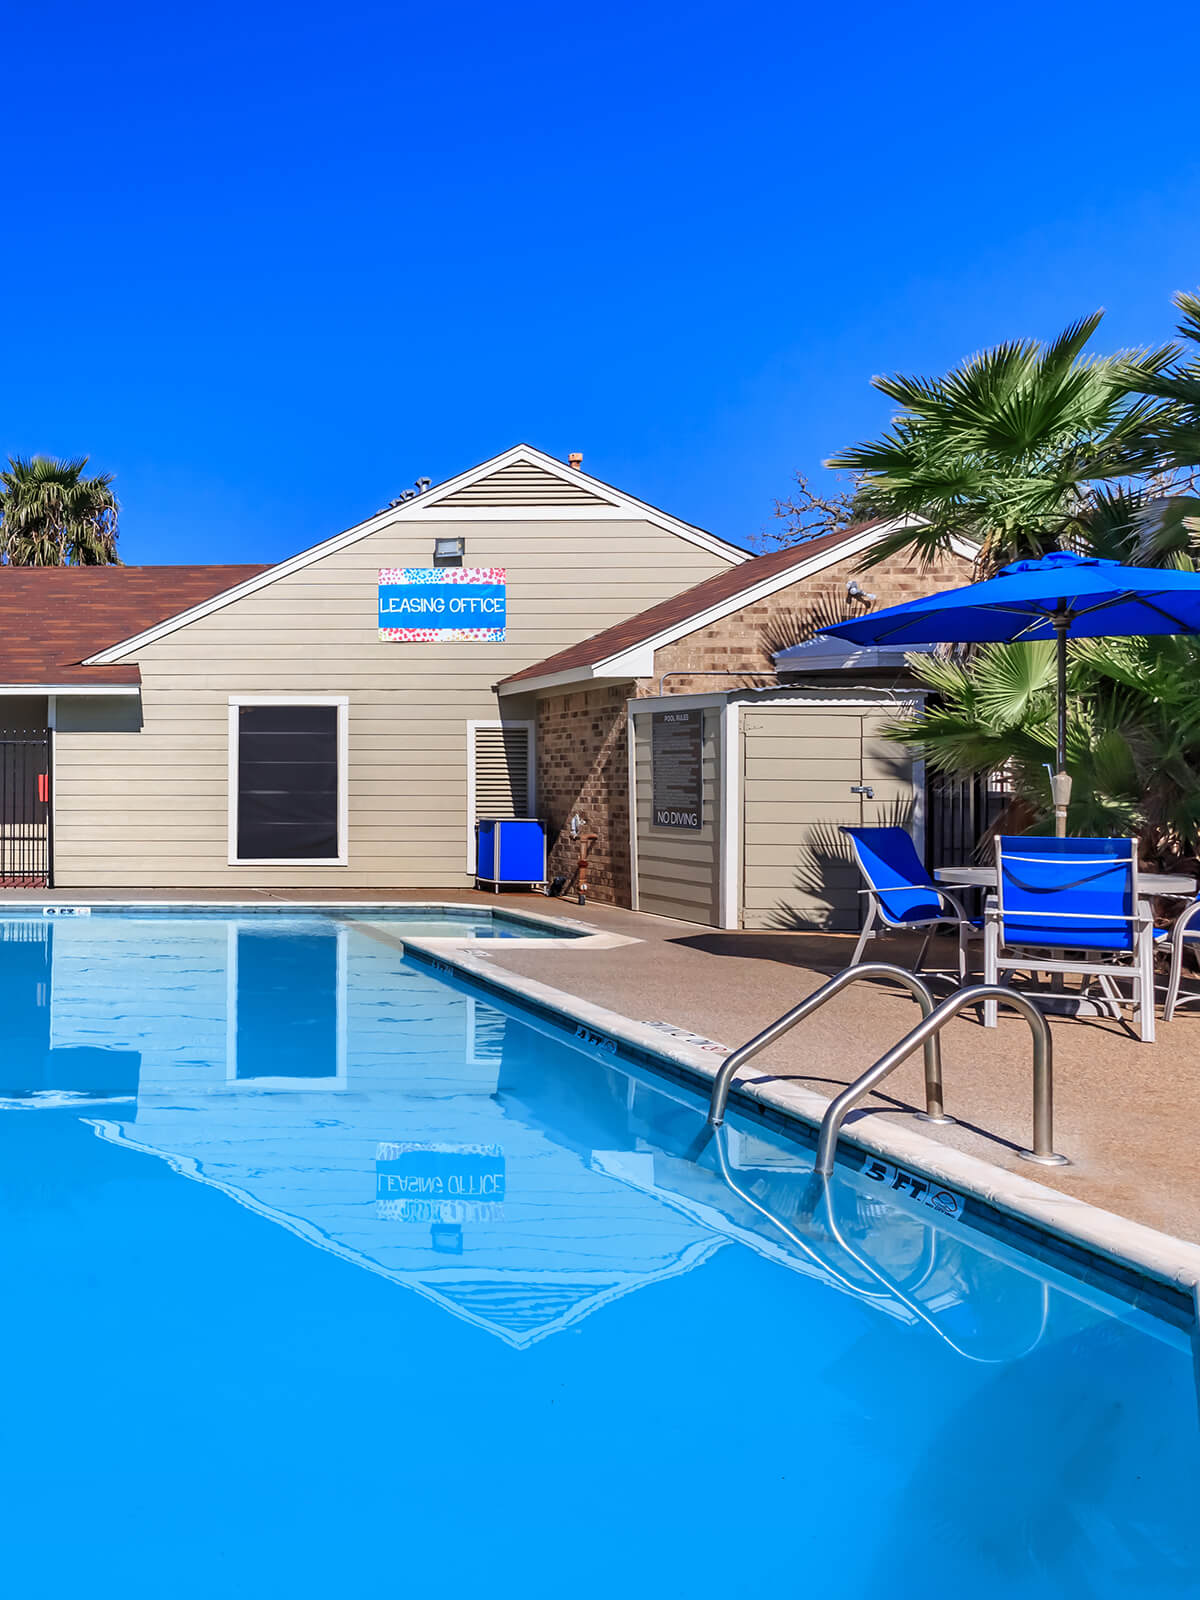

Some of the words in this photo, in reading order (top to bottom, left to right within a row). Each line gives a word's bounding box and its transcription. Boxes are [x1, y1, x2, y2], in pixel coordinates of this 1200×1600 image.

[379, 597, 445, 613] LEASING
[449, 597, 505, 613] OFFICE
[657, 811, 670, 824] NO
[670, 811, 698, 826] DIVING
[865, 1162, 887, 1182] 5
